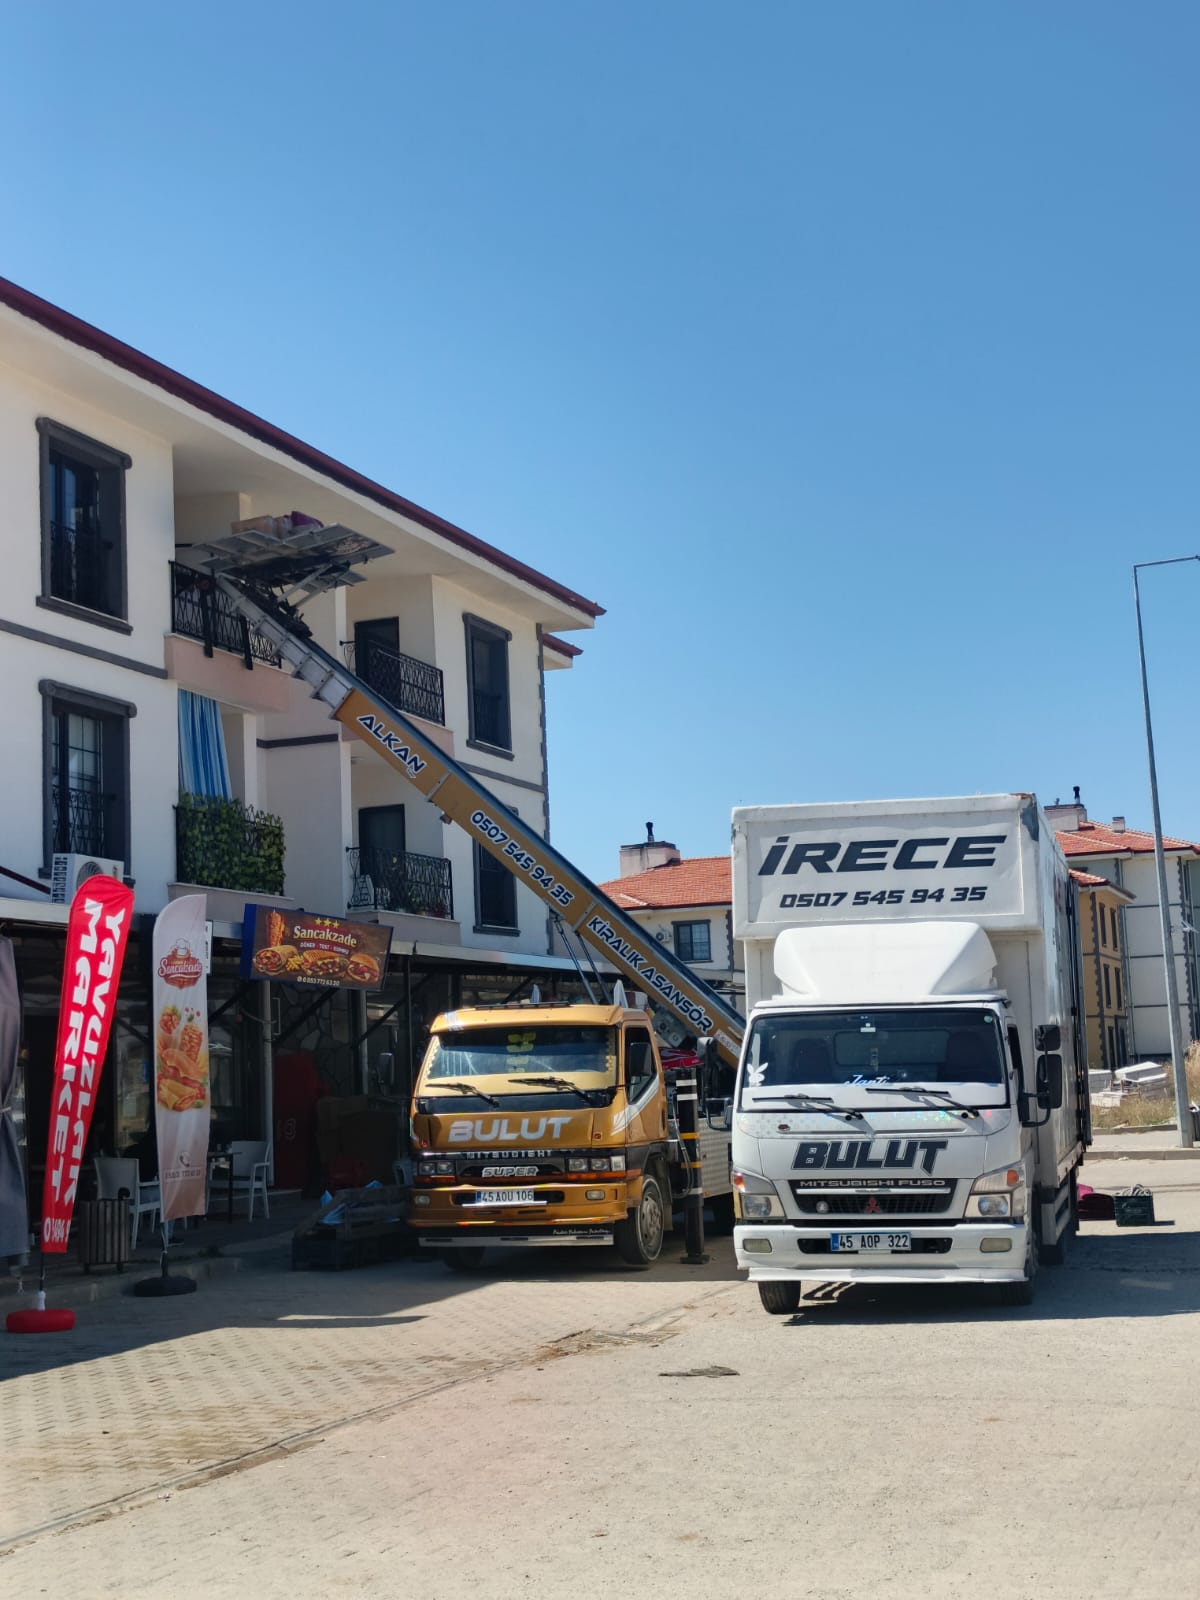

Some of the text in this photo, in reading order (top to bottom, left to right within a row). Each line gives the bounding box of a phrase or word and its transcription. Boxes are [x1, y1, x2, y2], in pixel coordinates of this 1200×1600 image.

[357, 714, 426, 773] ALKAN
[471, 811, 574, 906] 0507 545 94 35
[779, 886, 988, 908] 0507 545 94 35
[294, 926, 357, 947] Sancakzade
[641, 967, 714, 1033] ASANSÖR
[53, 898, 103, 1202] MARKET
[449, 1118, 572, 1142] BULUT
[791, 1139, 948, 1176] BULUT
[482, 1166, 539, 1177] SUPER
[482, 1192, 494, 1202] 45
[517, 1190, 533, 1200] 106
[839, 1236, 853, 1249] 45
[888, 1234, 909, 1248] 322
